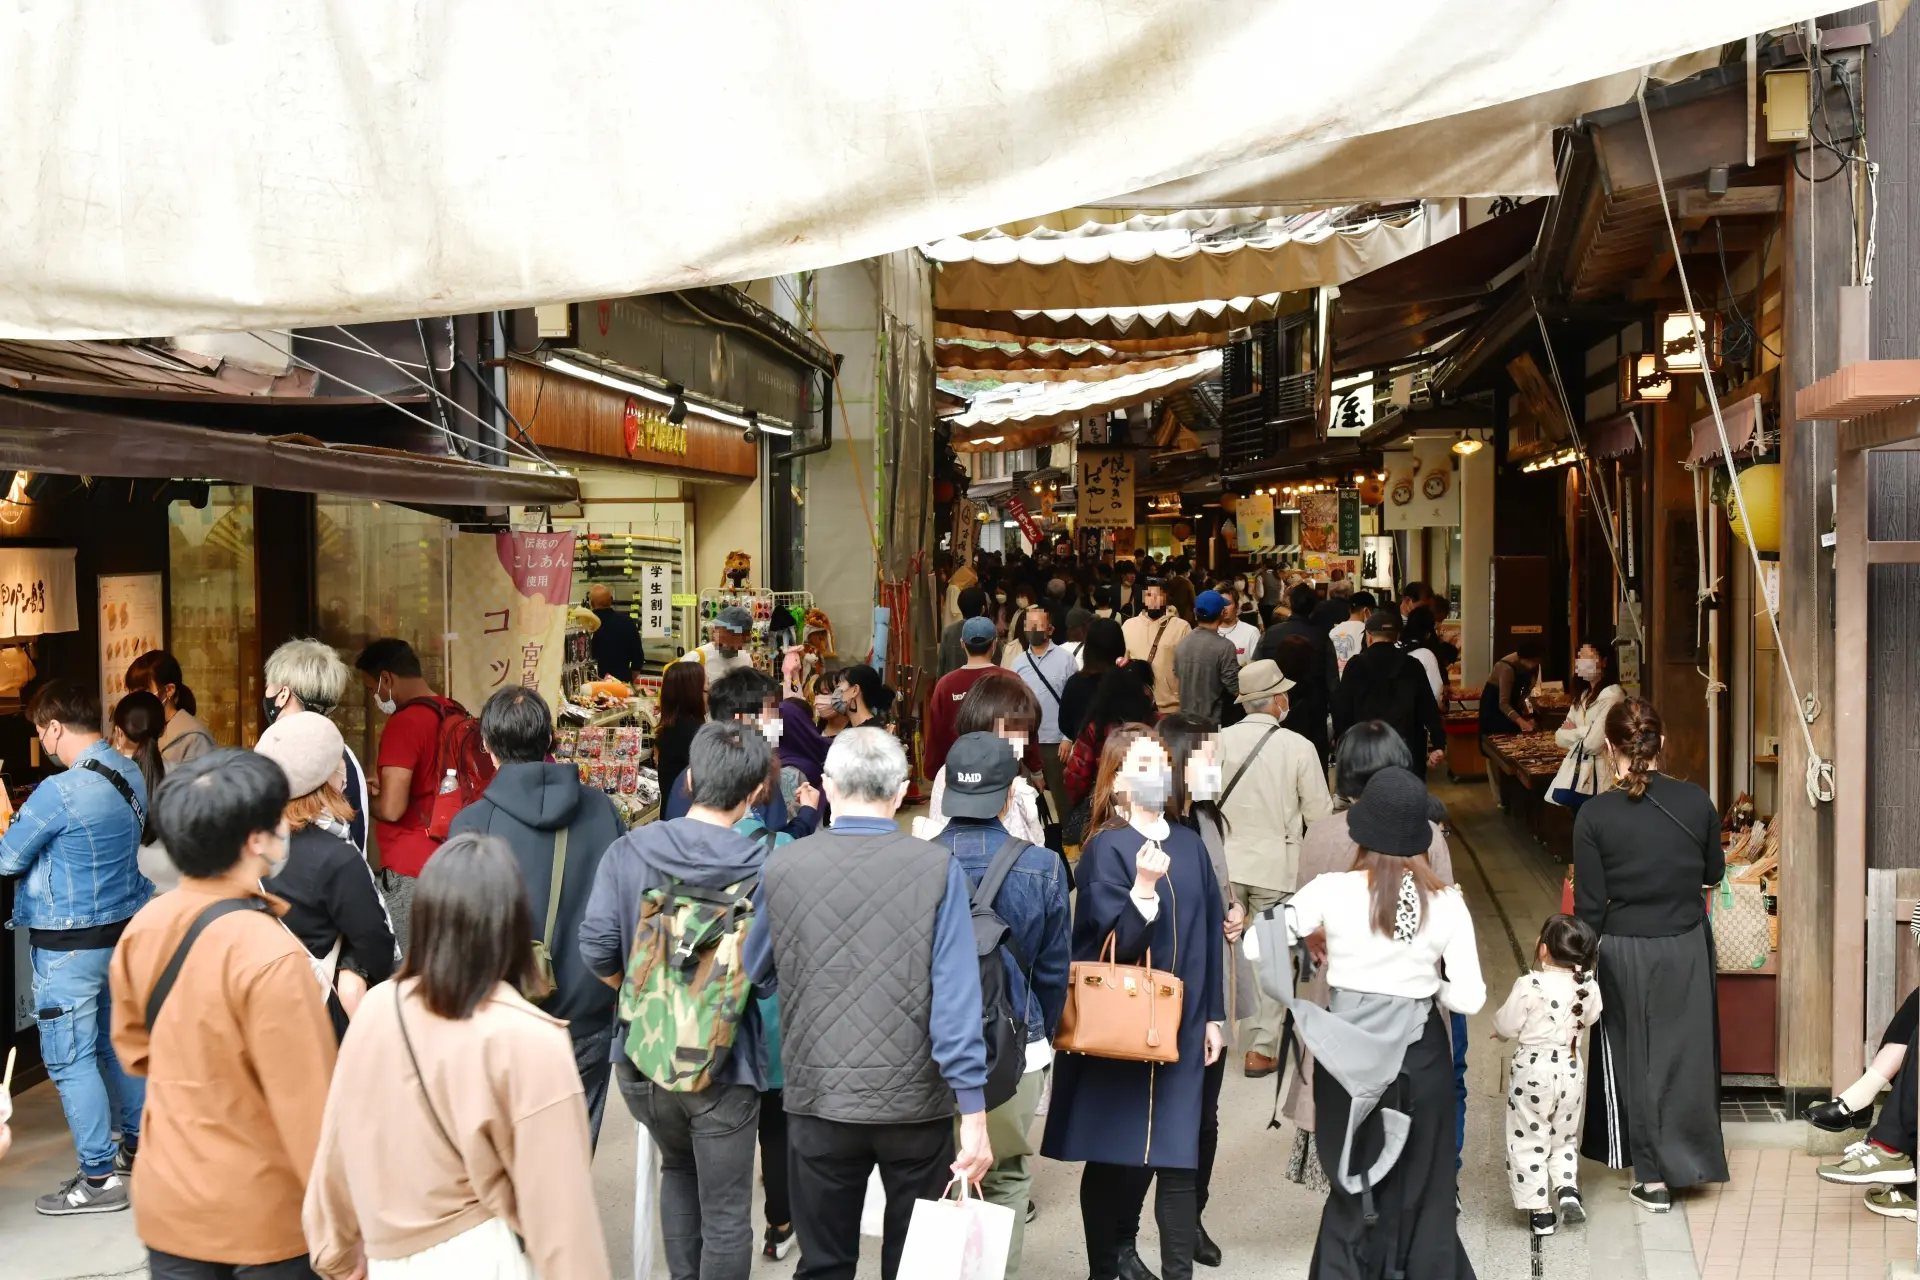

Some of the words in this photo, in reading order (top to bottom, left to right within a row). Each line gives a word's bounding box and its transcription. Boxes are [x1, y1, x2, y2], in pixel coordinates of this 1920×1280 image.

[1085, 462, 1106, 515] はやし
[525, 538, 558, 549] 伝統の
[514, 553, 568, 569] こしあん
[526, 576, 549, 588] 使用
[650, 565, 663, 628] 学生割引
[957, 771, 982, 783] RAID
